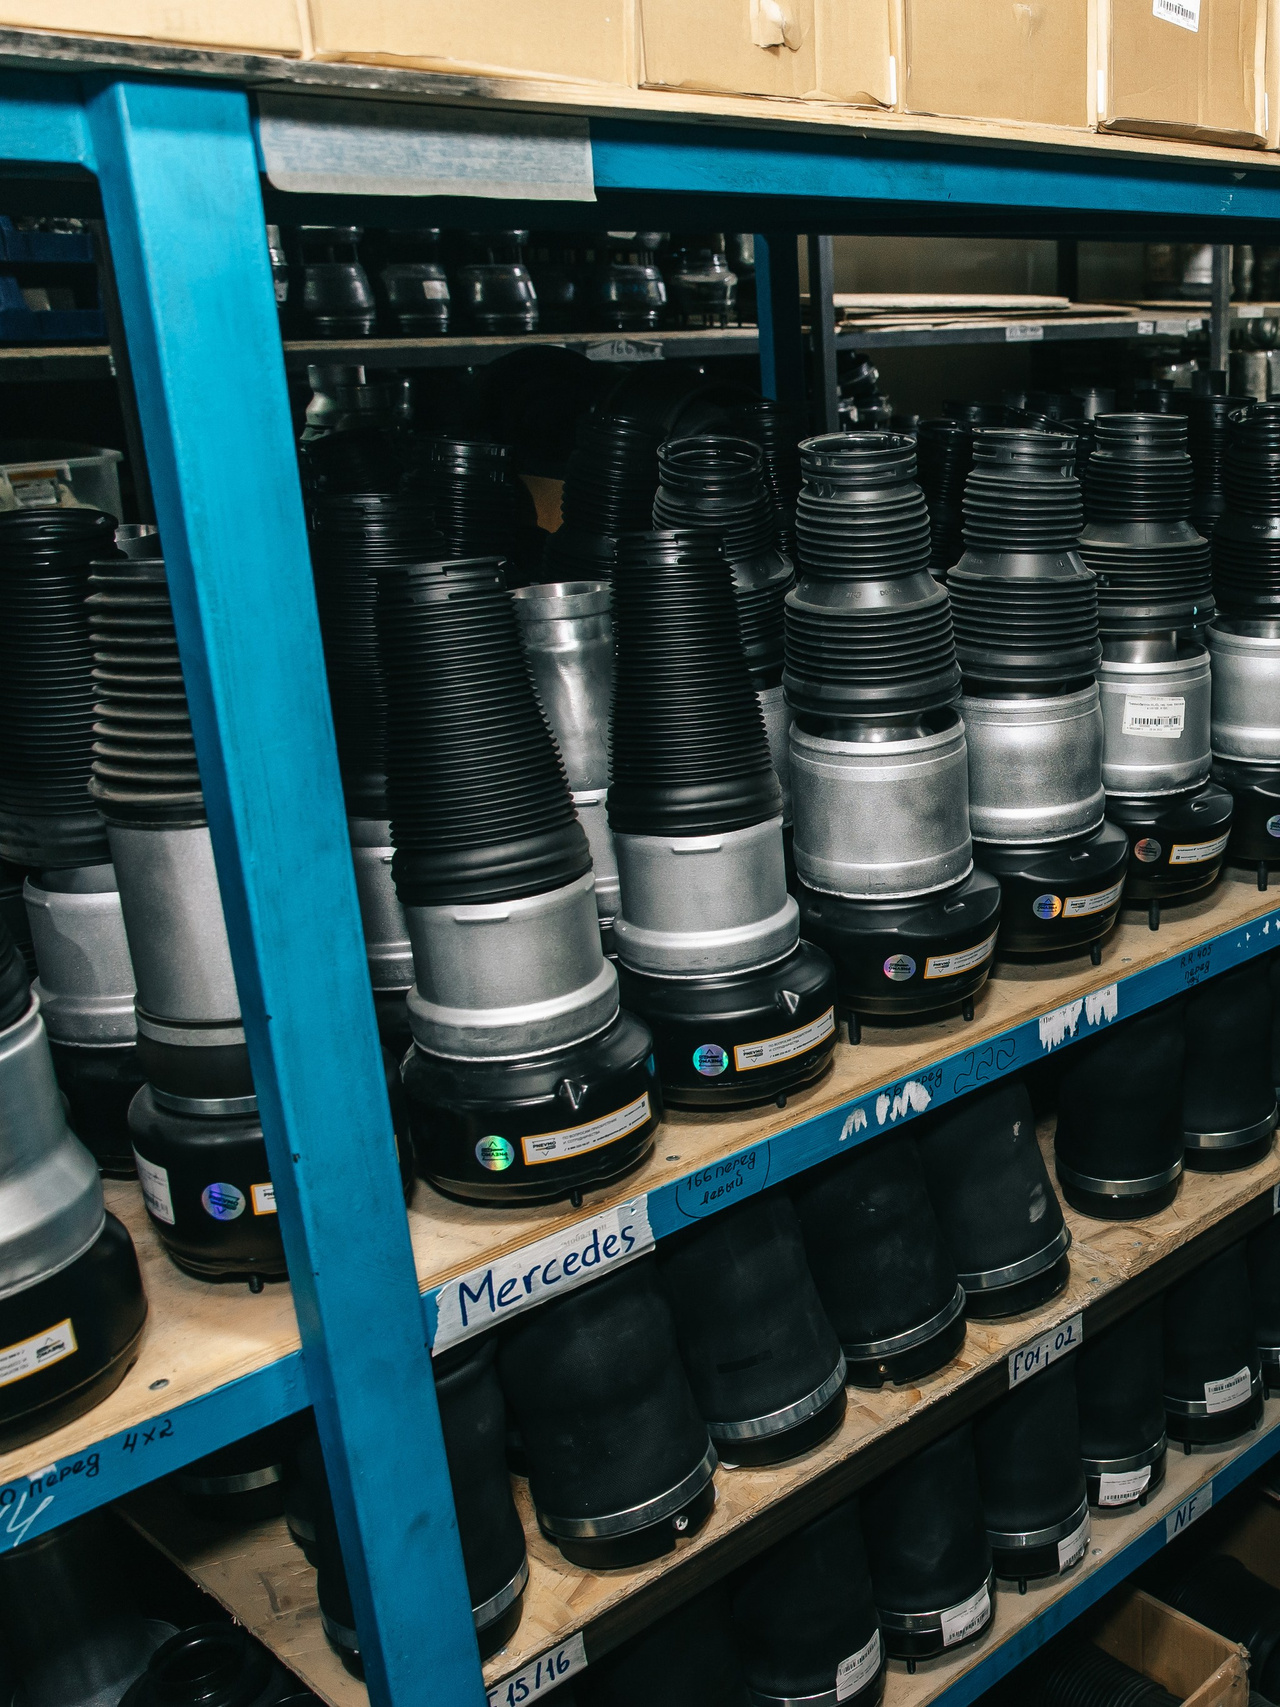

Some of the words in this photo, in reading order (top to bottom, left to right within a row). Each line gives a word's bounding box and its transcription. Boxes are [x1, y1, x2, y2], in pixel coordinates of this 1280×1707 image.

[532, 1140, 557, 1149] PNEVMO
[686, 1168, 712, 1191] 166
[715, 1151, 756, 1179] перед
[458, 1225, 636, 1327] Mercedes
[29, 1452, 101, 1498] перед
[1174, 1497, 1198, 1533] NF
